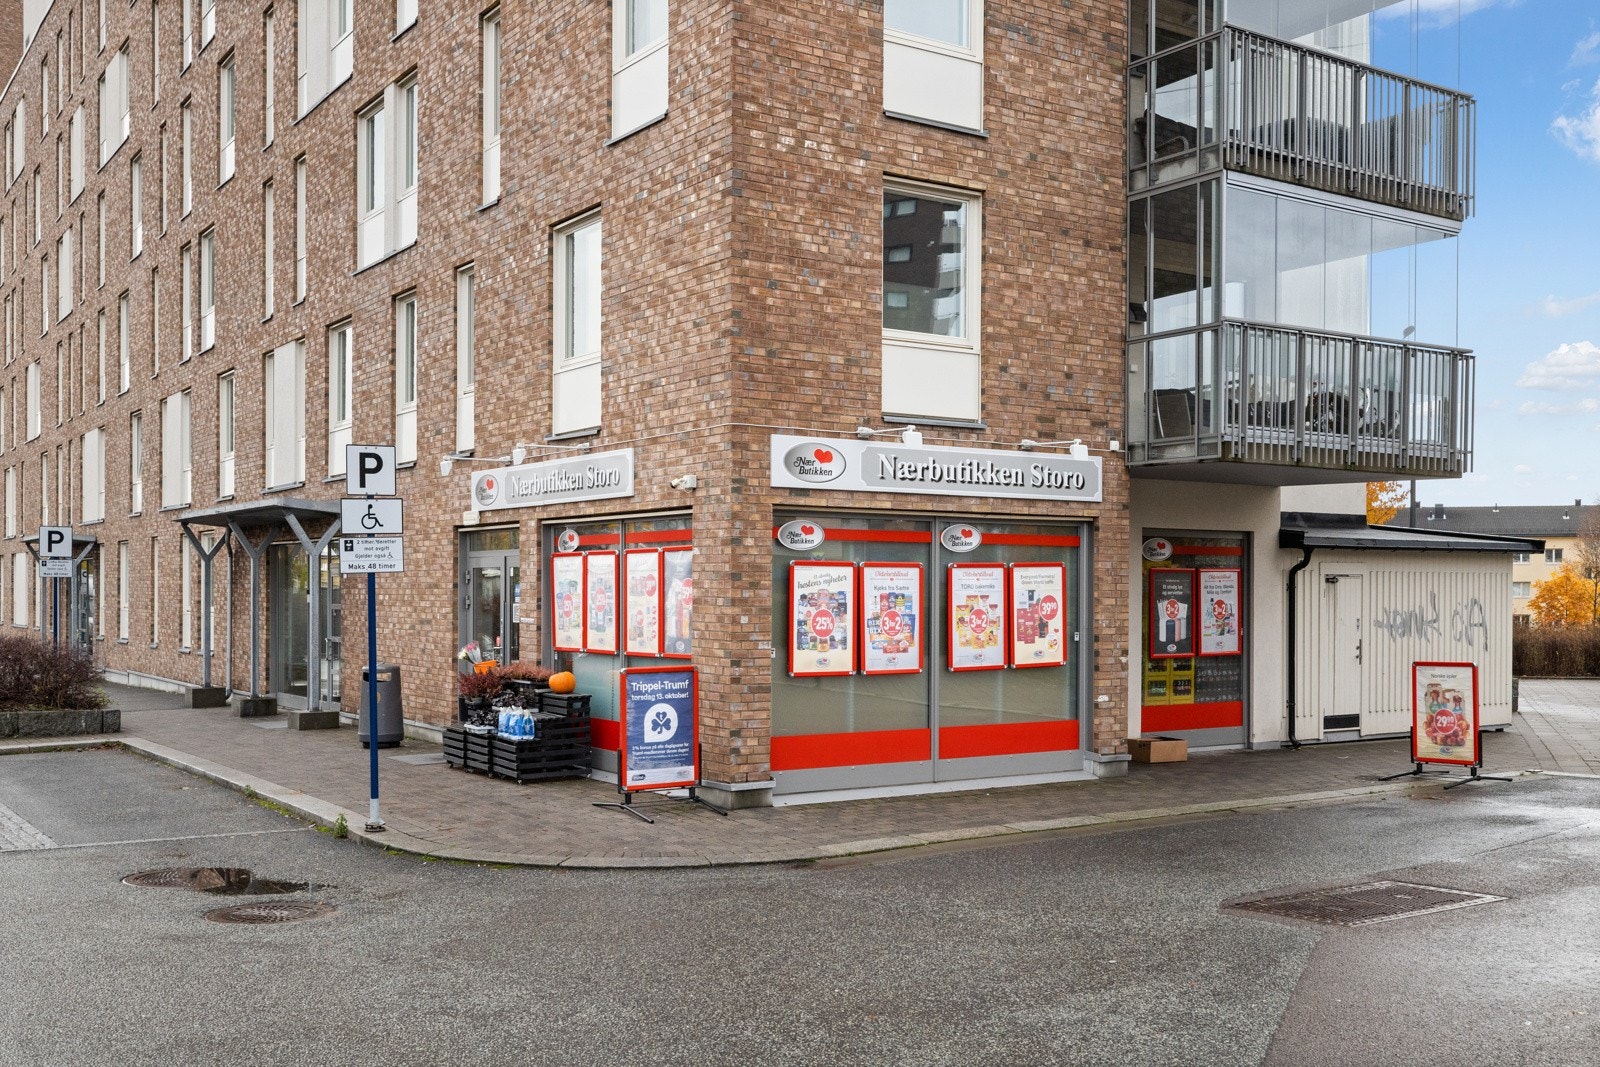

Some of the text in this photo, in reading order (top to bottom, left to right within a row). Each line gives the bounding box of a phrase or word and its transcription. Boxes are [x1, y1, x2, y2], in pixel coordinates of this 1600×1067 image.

[794, 456, 815, 467] Nær
[359, 452, 383, 488] P
[798, 467, 833, 476] Butikken
[877, 453, 1085, 490] Nærbutikken Storo
[511, 464, 621, 498] Nærbutikken Storo
[47, 530, 65, 553] P
[786, 531, 802, 540] Nær
[368, 562, 377, 570] 48
[1166, 604, 1171, 614] 3
[1174, 604, 1179, 614] 2
[1214, 604, 1218, 615] 3
[1221, 604, 1226, 615] 2
[813, 616, 834, 631] -25%
[883, 617, 890, 630] 3
[895, 616, 901, 630] 2
[970, 615, 976, 627] 3
[981, 615, 987, 627] 2
[631, 680, 689, 693] Trippel-Trumf
[665, 692, 689, 700] oktober!
